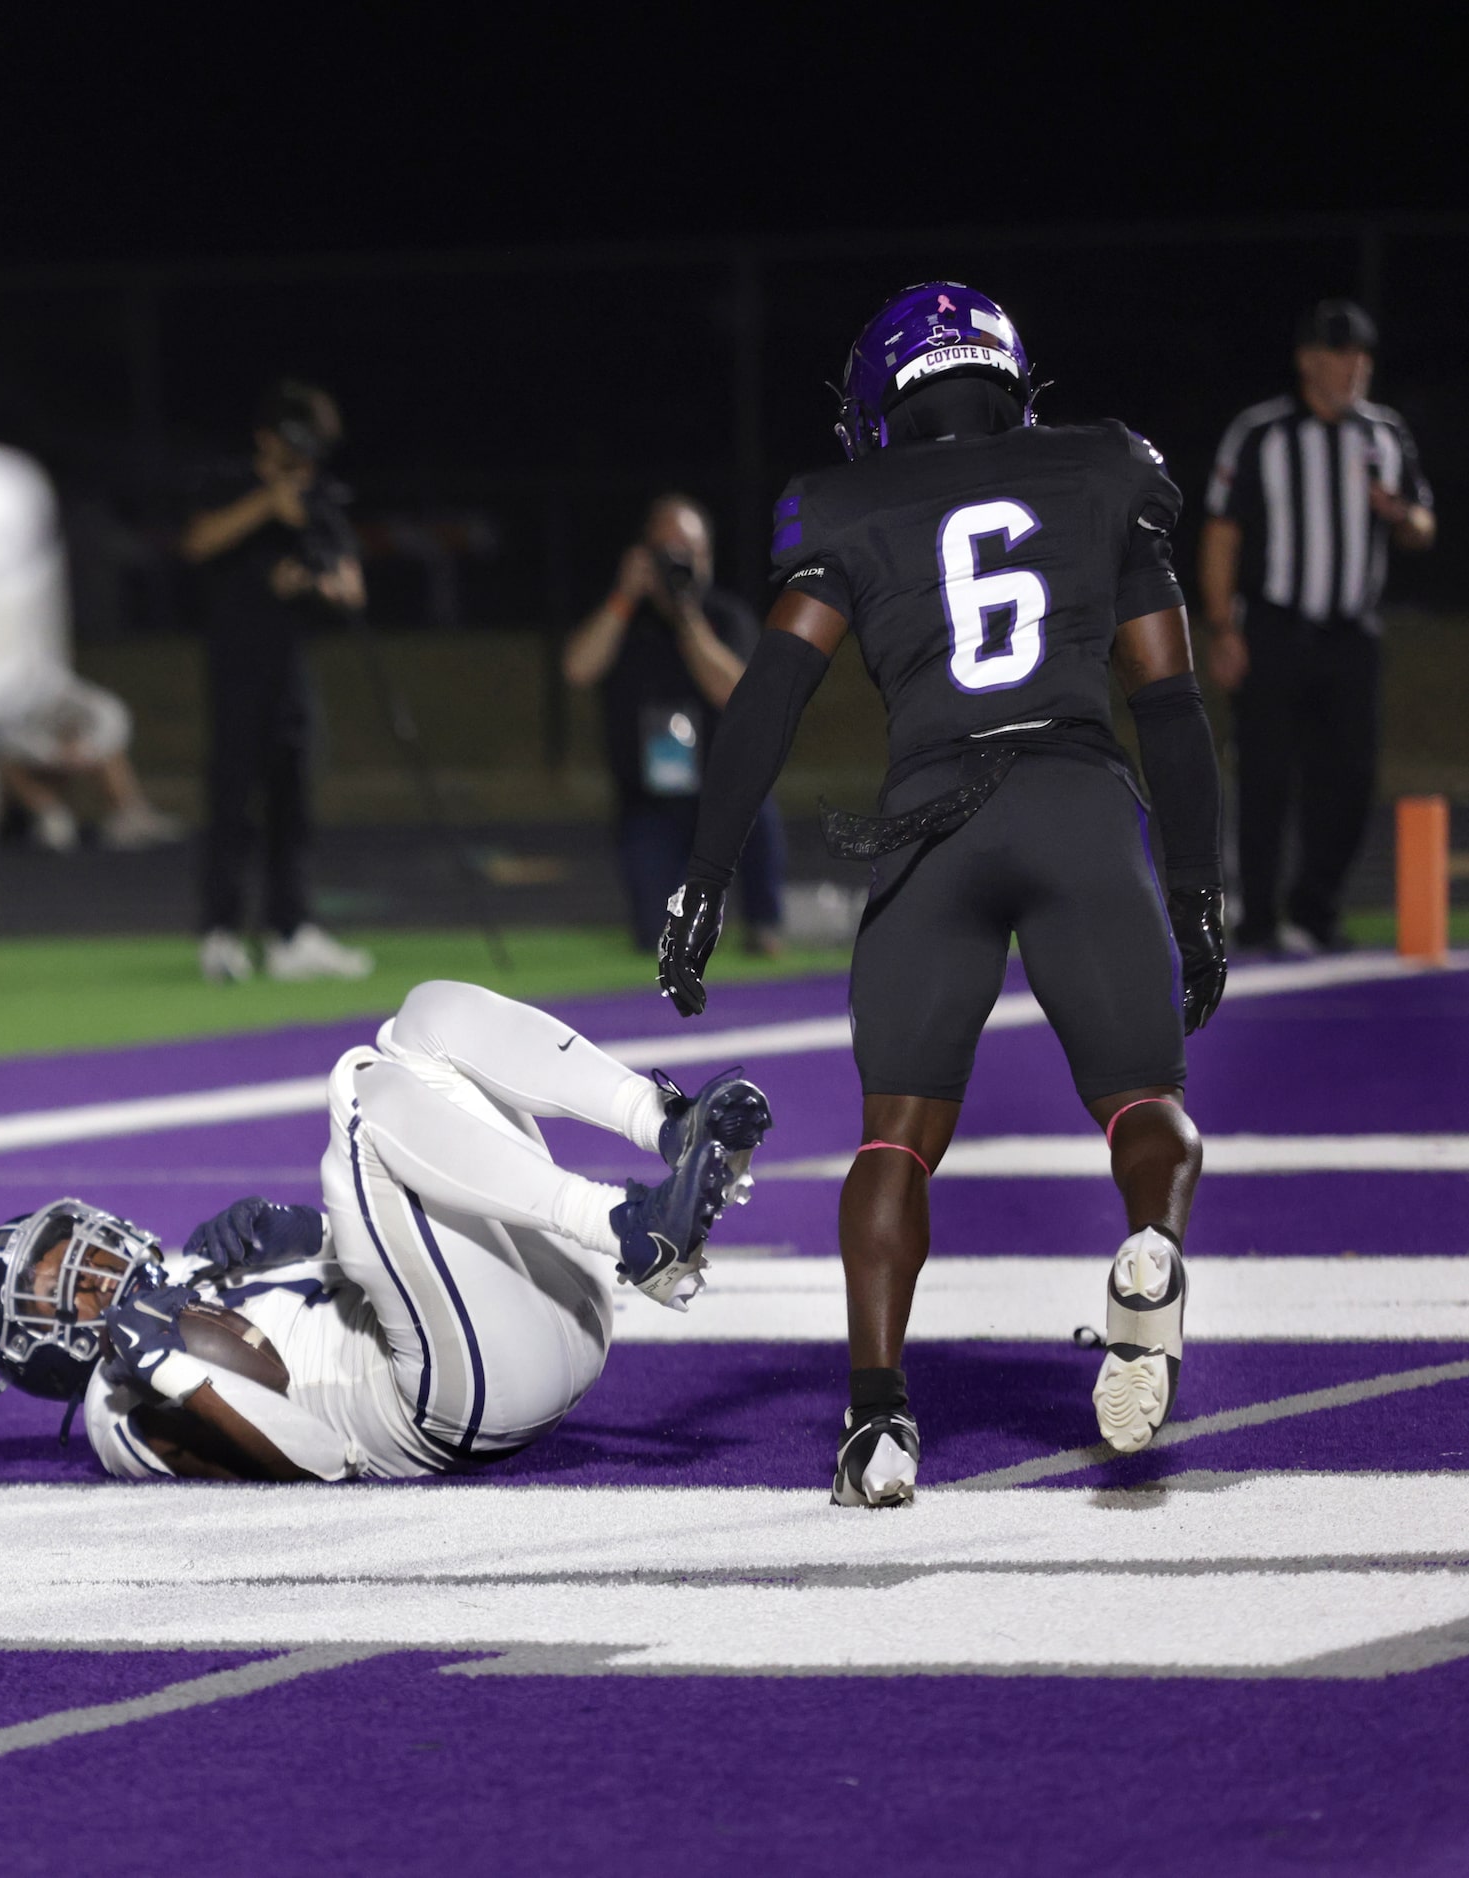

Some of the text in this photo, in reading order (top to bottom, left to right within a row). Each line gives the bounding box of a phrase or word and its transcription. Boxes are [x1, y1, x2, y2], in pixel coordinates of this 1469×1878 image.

[926, 346, 991, 366] COYOTE U
[936, 497, 1051, 694] 6
